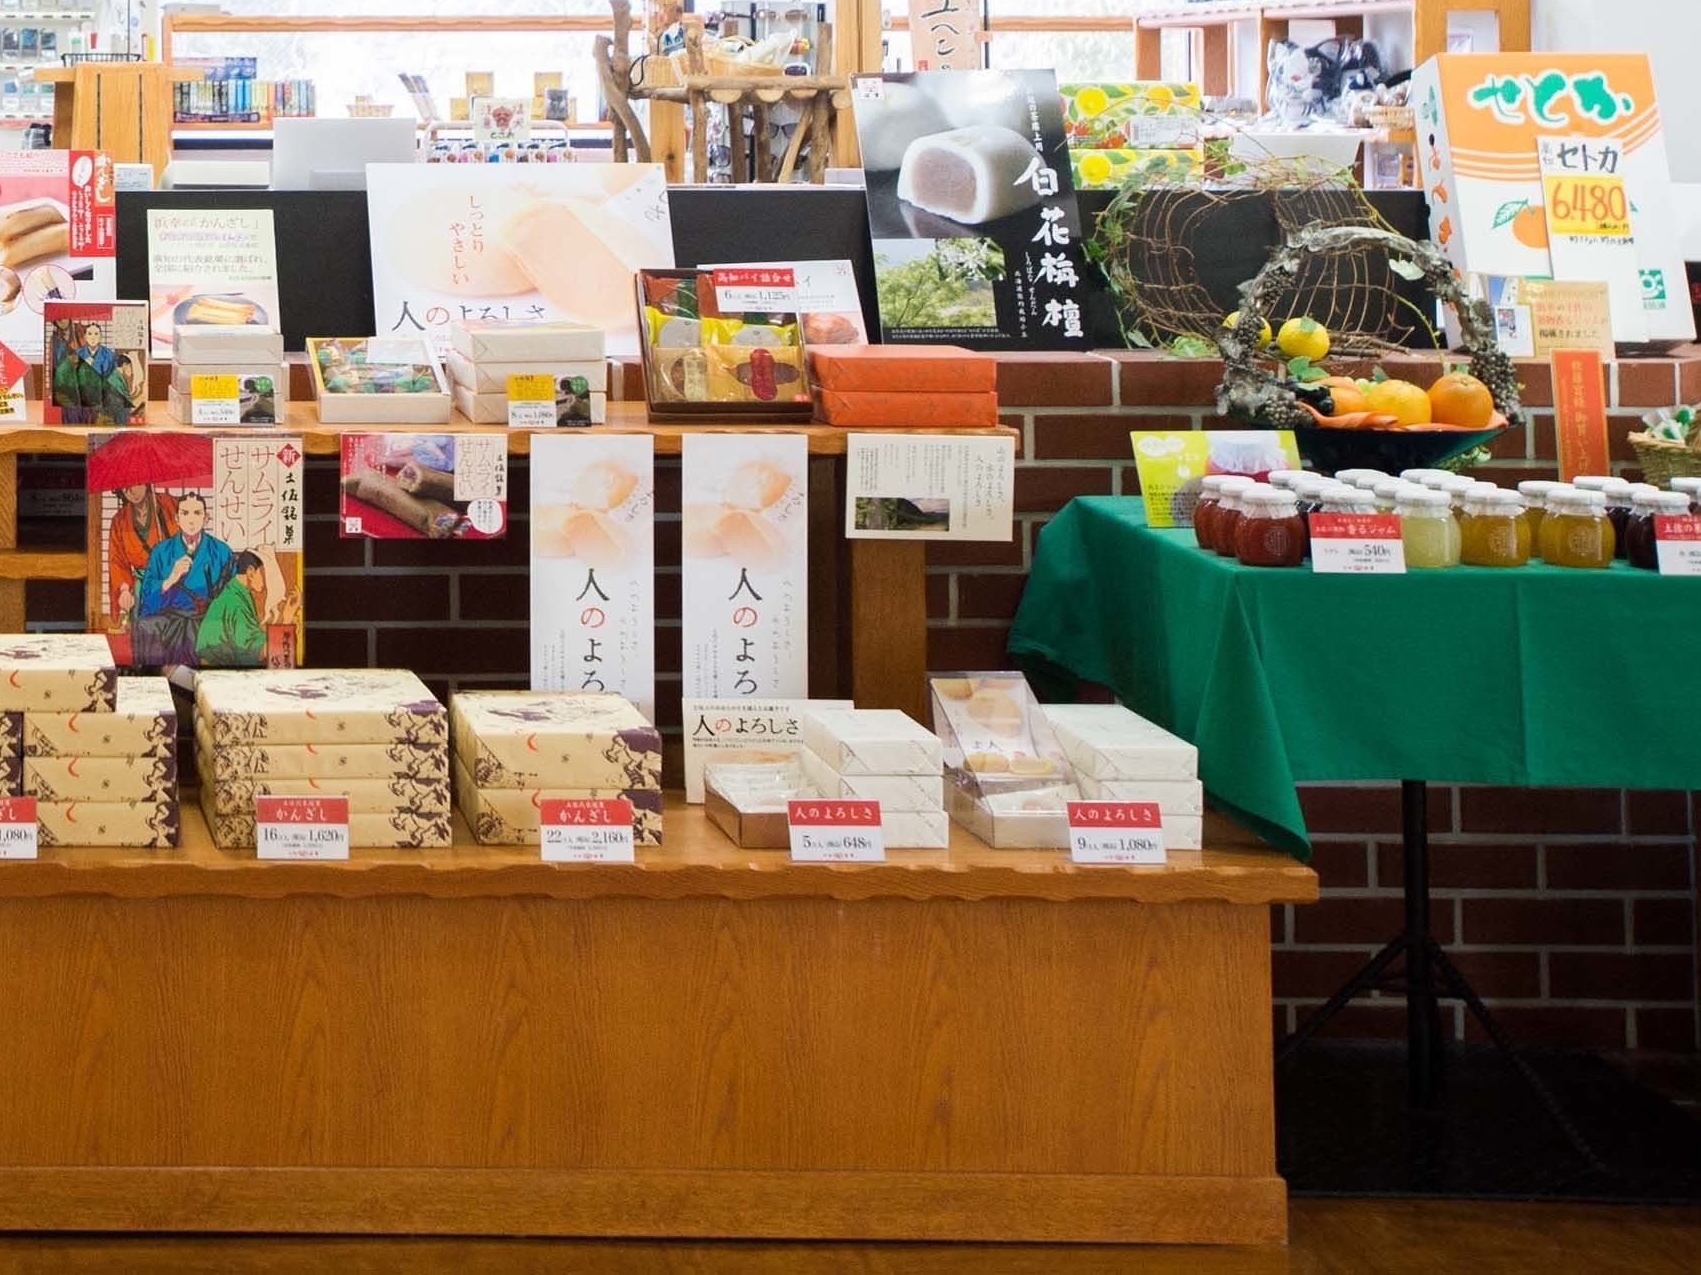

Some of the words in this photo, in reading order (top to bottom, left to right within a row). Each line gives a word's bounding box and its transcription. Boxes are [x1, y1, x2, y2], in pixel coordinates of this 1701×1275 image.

[1471, 72, 1633, 123] せとか
[1557, 142, 1620, 174] セトカ
[470, 195, 484, 254] しっとり
[449, 222, 470, 286] やさしい
[282, 449, 296, 464] 新
[220, 445, 246, 542] せんせい
[251, 445, 275, 545] サムライ
[281, 472, 298, 545] 土佐銘菓
[576, 567, 610, 691] 人のよろ
[728, 567, 762, 694] 人のよろ
[692, 715, 799, 737] 人のよろしさ
[276, 808, 327, 821] かんざし
[559, 809, 611, 823] かんざし
[795, 807, 873, 820] 人のよろしさ
[1075, 808, 1152, 821] 人のよろしさ
